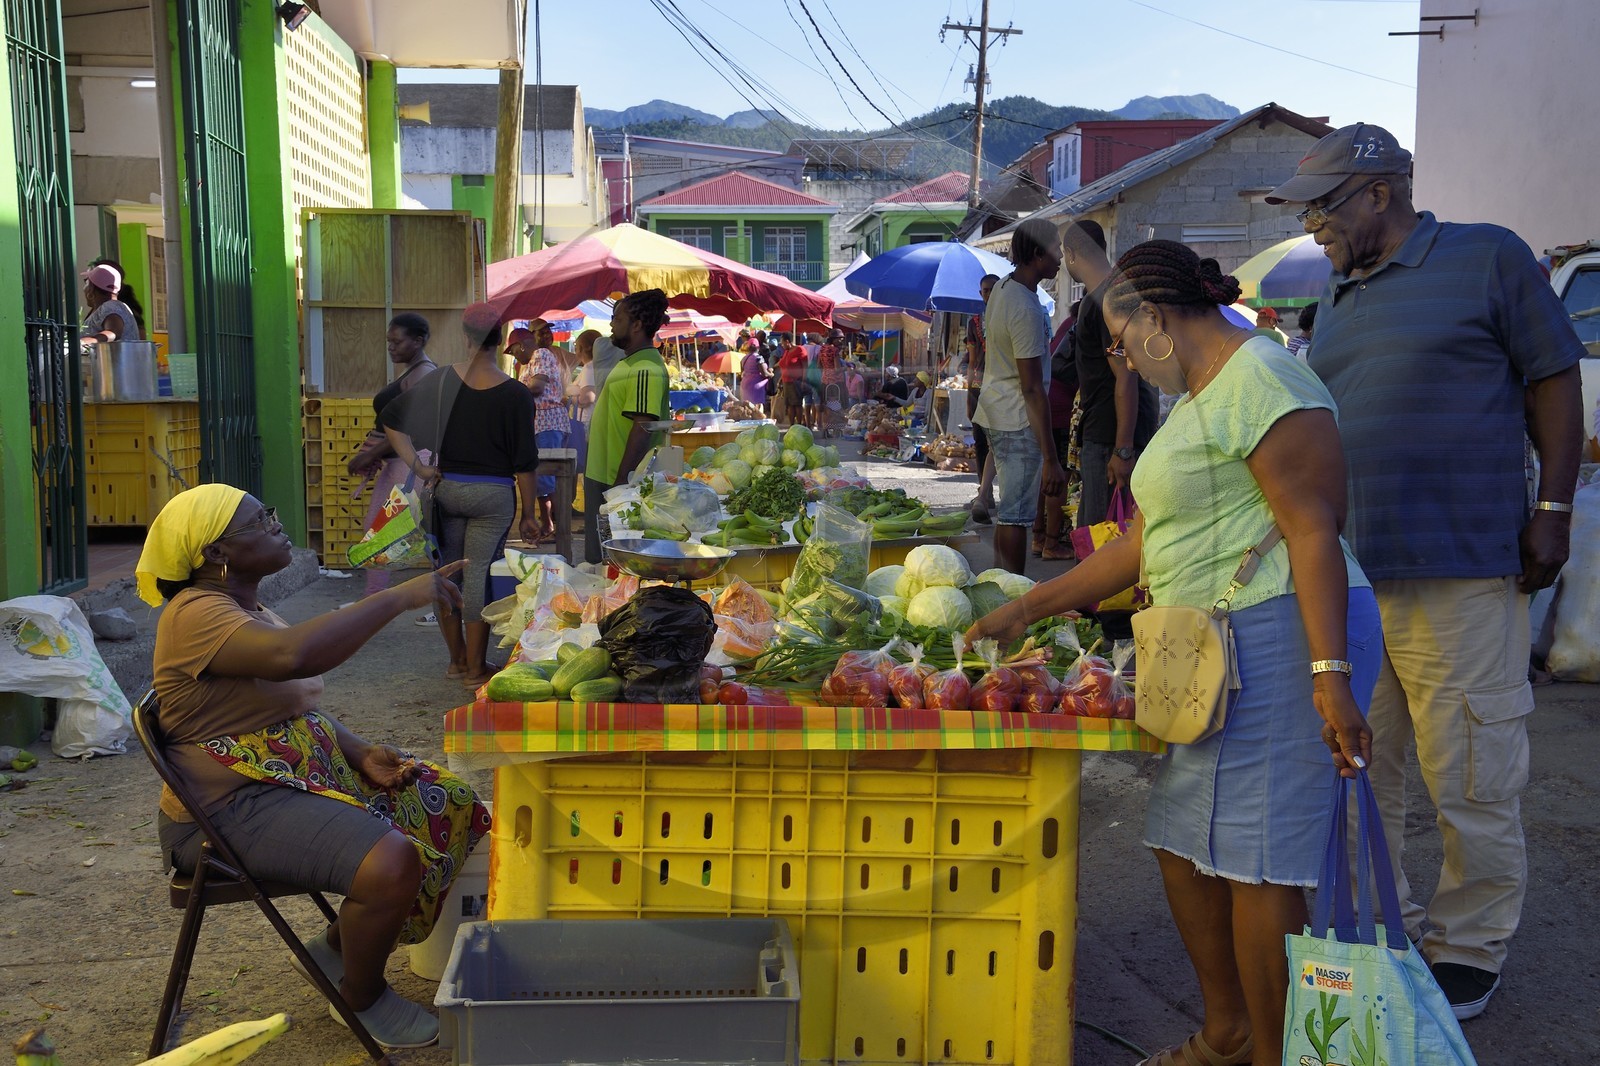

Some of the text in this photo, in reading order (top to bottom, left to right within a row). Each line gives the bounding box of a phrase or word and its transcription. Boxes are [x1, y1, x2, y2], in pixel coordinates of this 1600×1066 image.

[1353, 143, 1379, 159] 72
[1315, 966, 1351, 981] MASSY
[1316, 976, 1353, 991] STORES
